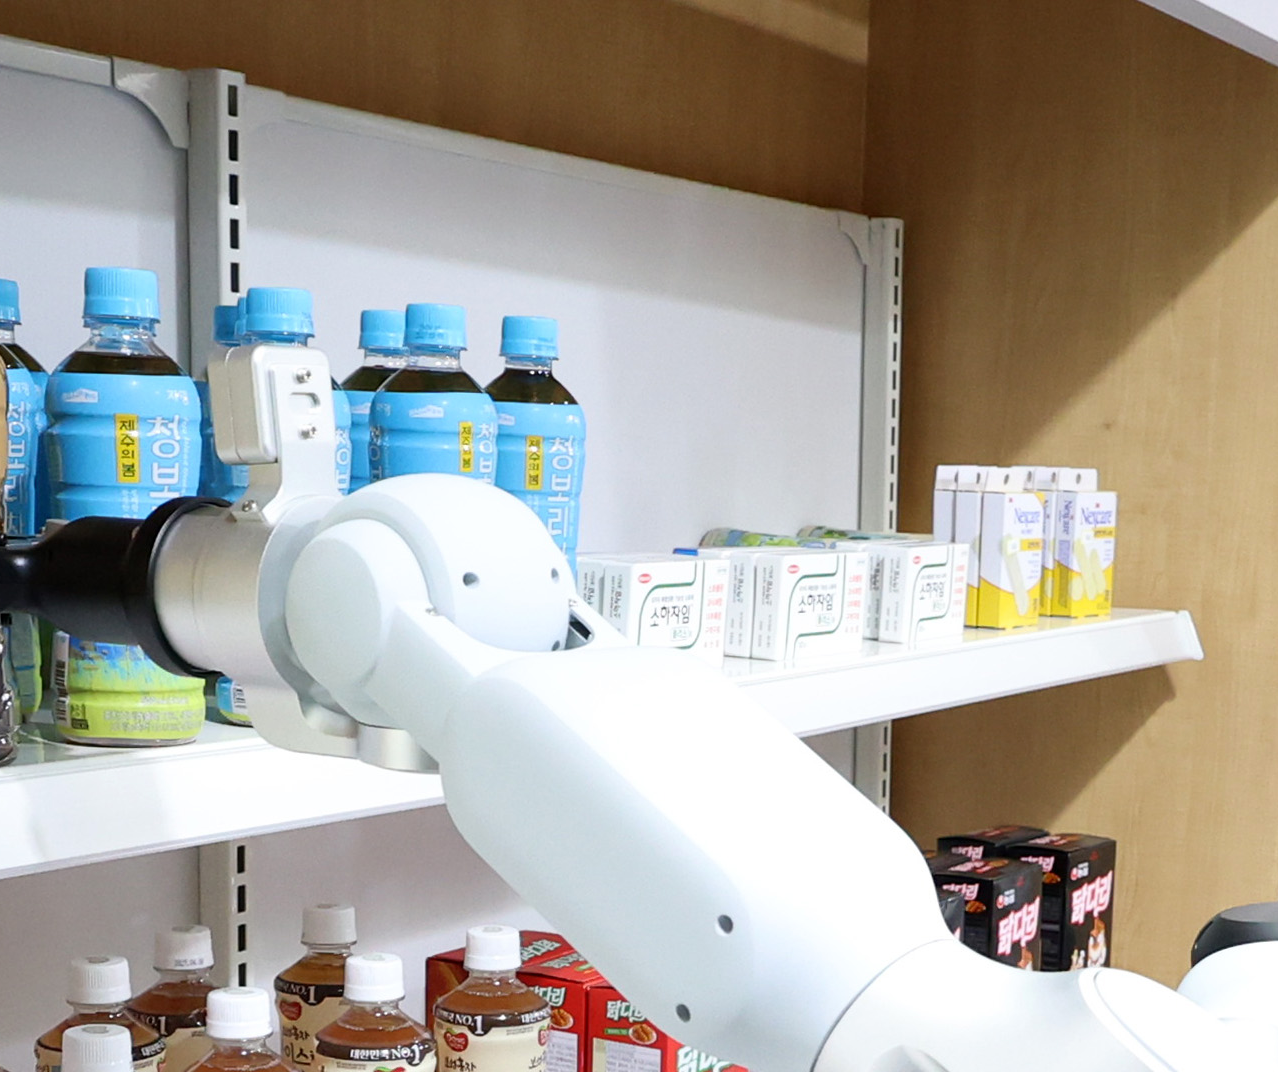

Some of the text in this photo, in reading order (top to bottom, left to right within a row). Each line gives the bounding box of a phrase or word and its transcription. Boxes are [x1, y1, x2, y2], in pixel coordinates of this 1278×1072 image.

[146, 414, 181, 499] 청보
[1014, 508, 1041, 529] Nexcare
[1081, 507, 1113, 528] Nexcare
[919, 581, 946, 601] 소하자임
[798, 592, 835, 614] 소하자임
[650, 604, 693, 627] 소하자임
[454, 1013, 485, 1036] NO.1
[350, 1044, 422, 1066] 대한민국 NO.1
